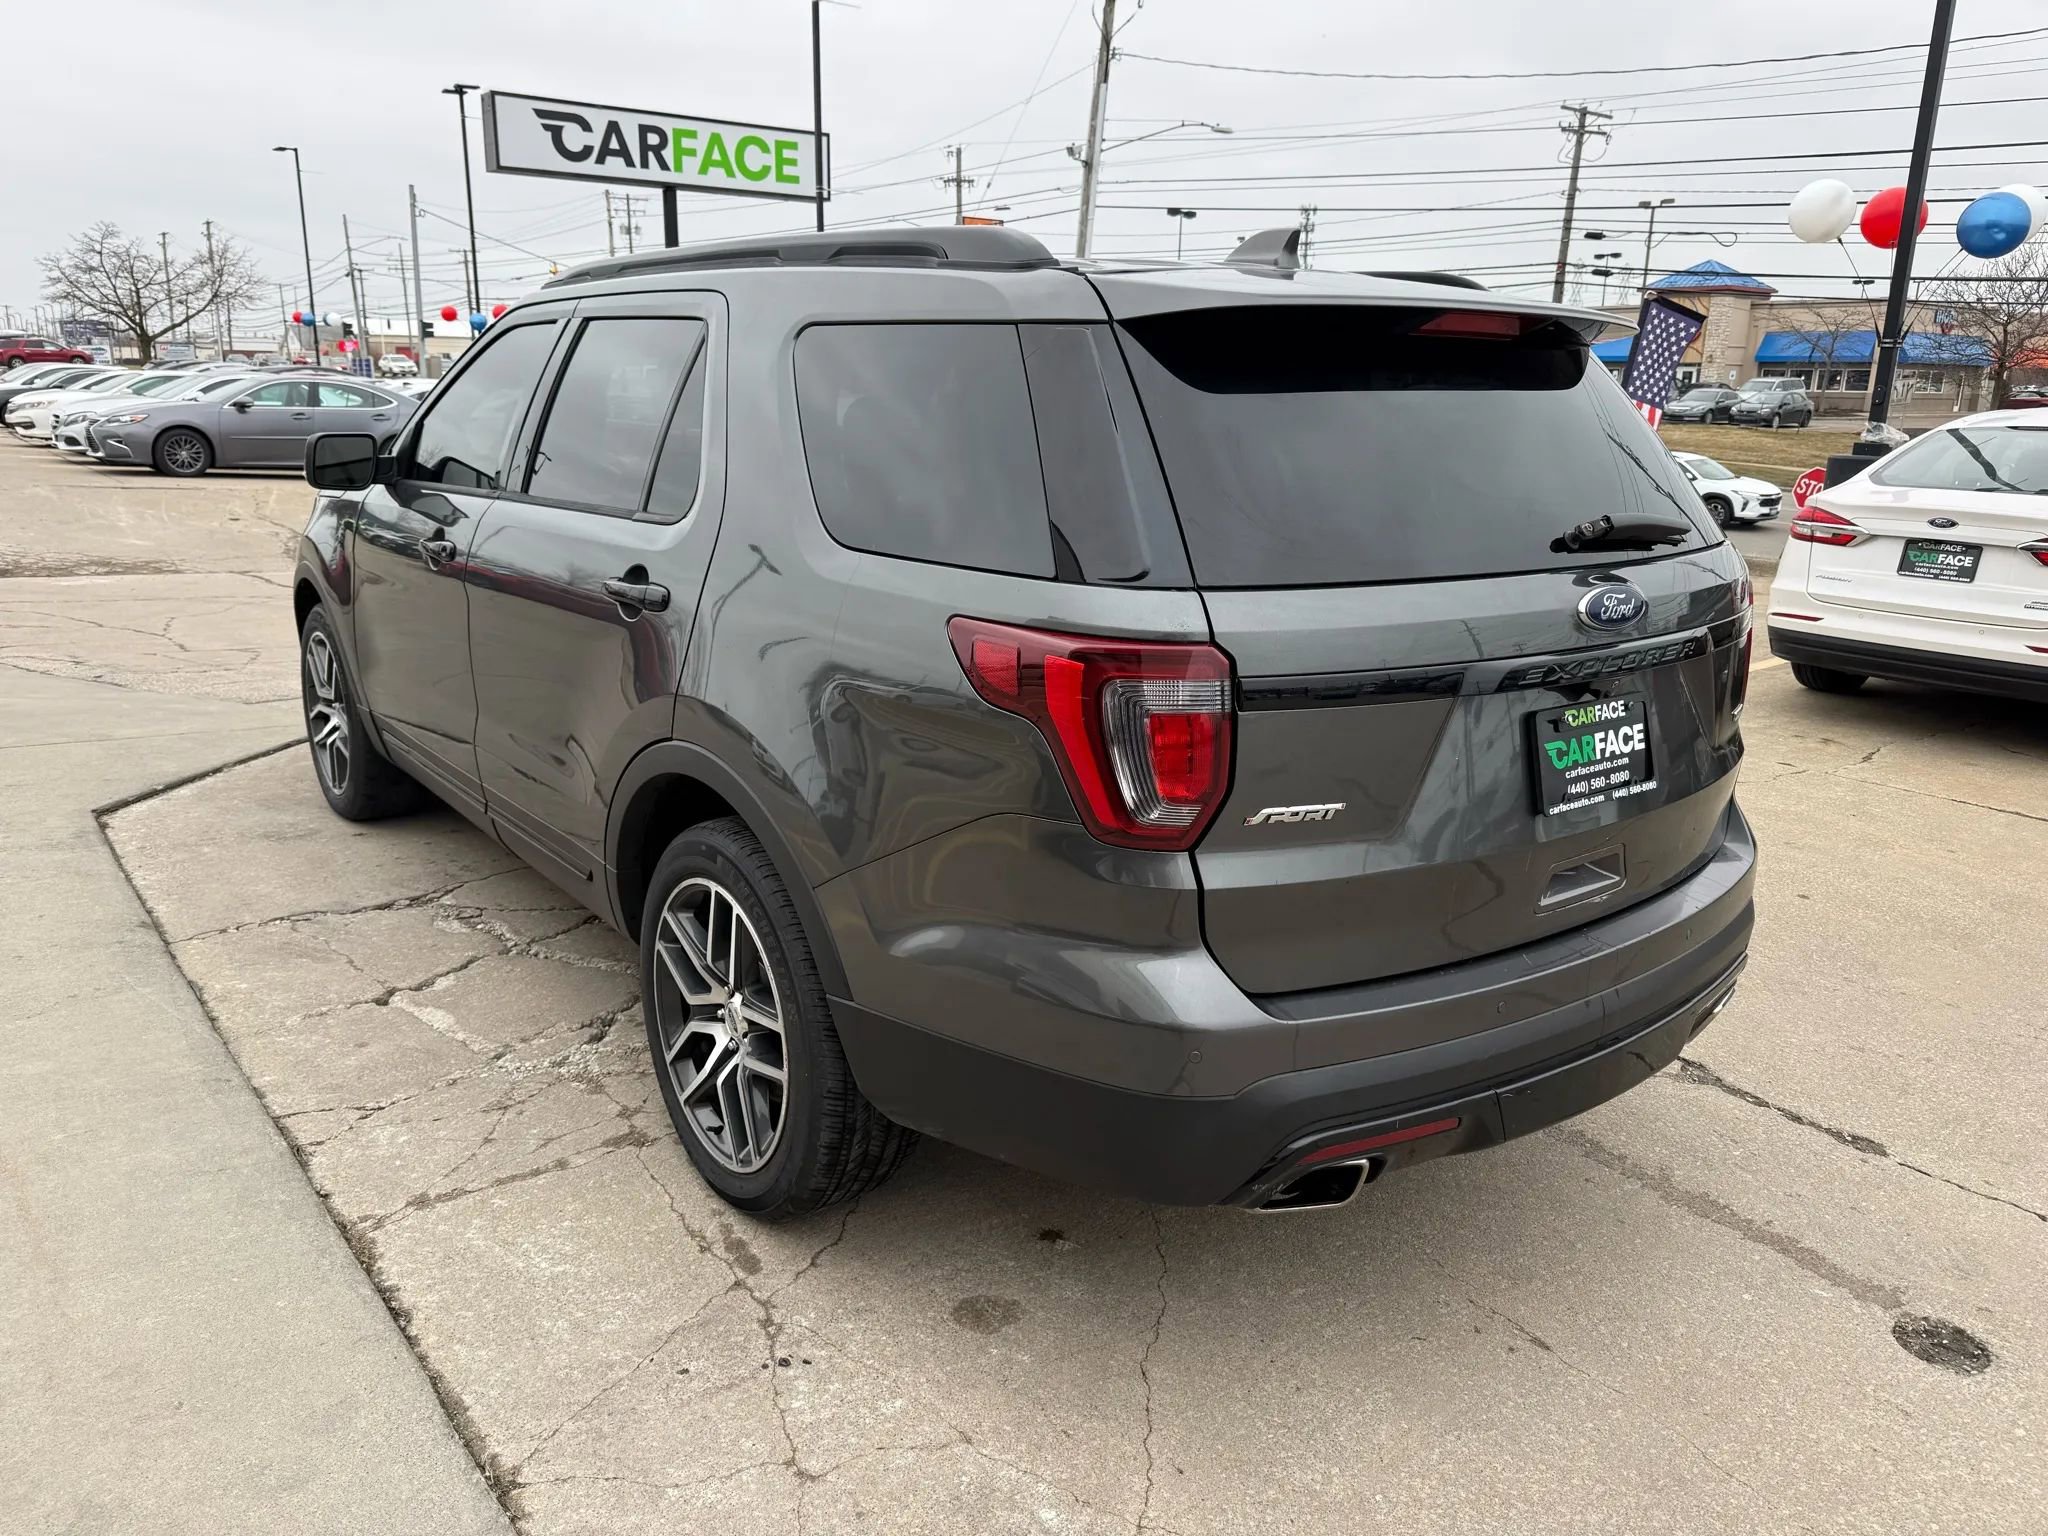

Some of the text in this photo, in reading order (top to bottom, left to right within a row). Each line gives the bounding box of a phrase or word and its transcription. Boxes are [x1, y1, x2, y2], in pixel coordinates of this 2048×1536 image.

[532, 108, 800, 185] CARFACE
[1796, 478, 1825, 496] STO
[1907, 550, 1974, 567] CARFACE
[1922, 541, 1962, 552] CARFACE
[1600, 593, 1636, 621] Ford
[1518, 641, 1696, 686] EXPLORER
[1564, 700, 1626, 727] CARFACE
[1544, 723, 1646, 770] CARFACE
[1565, 757, 1630, 779] carfaceauto.com
[1567, 779, 1589, 795] (440)
[1549, 794, 1605, 816] carfaceauto.com
[1612, 787, 1629, 800] (440)
[1243, 803, 1347, 826] SPORT
